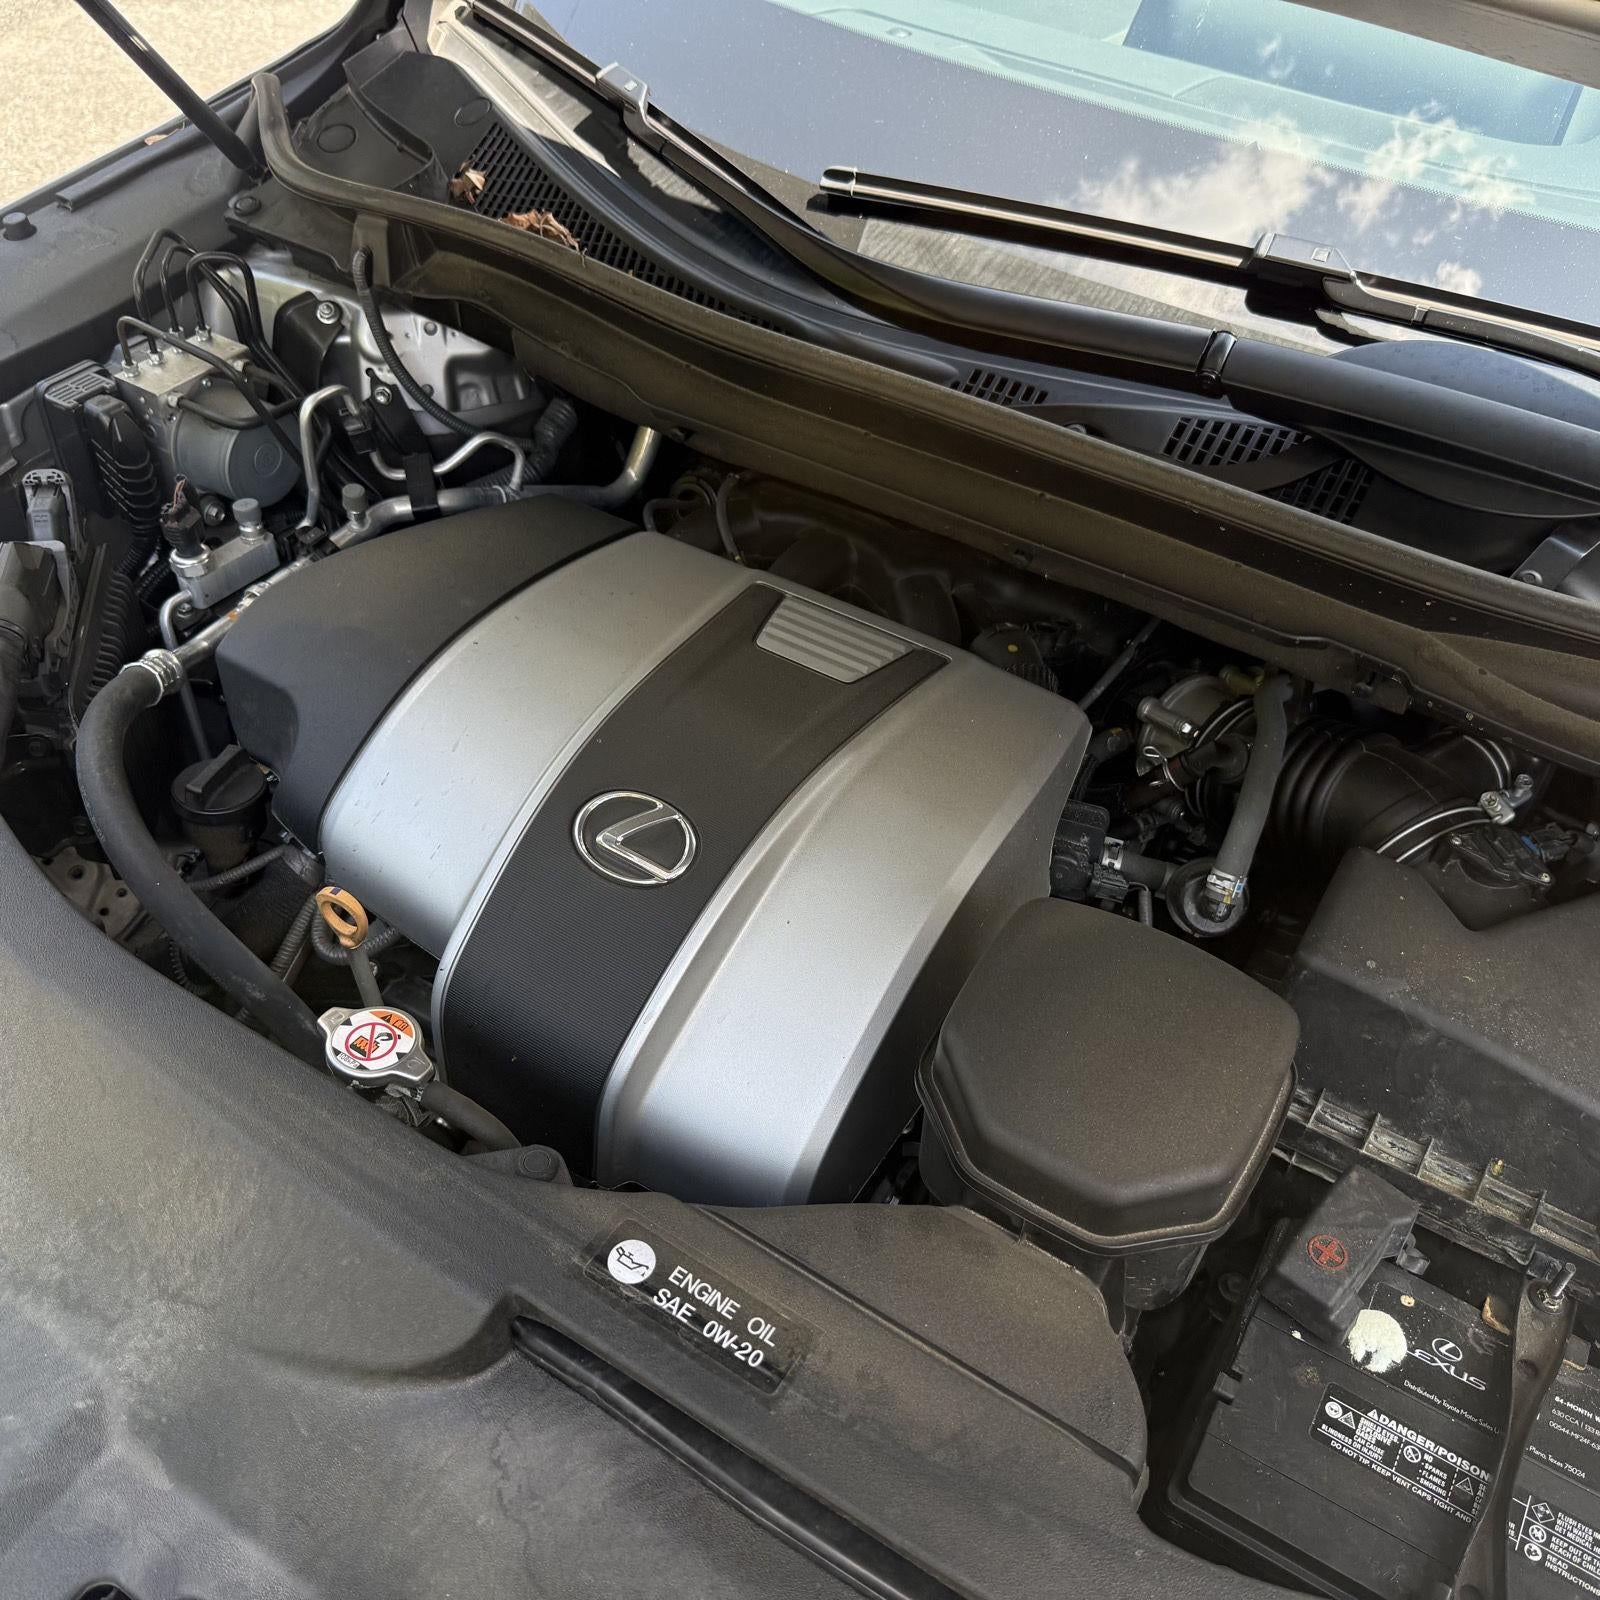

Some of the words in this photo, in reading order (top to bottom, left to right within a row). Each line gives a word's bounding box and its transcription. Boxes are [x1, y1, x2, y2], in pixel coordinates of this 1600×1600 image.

[668, 1265, 741, 1320] ENGINE
[747, 1317, 776, 1347] OIL
[653, 1288, 697, 1323] SAE
[702, 1320, 764, 1368] 0W-20
[1407, 1349, 1487, 1391] EXUS
[1403, 1379, 1435, 1400] Distributed
[1434, 1395, 1442, 1405] by
[1442, 1399, 1460, 1414] Toyota
[1460, 1408, 1478, 1423] Motor
[1478, 1418, 1493, 1432] Sales
[1552, 1408, 1565, 1419] 630
[1564, 1414, 1580, 1426] CCA
[1555, 1395, 1594, 1419] 84-MONTH
[1321, 1423, 1353, 1446] BLINDNESS
[1352, 1442, 1362, 1451] OR
[1355, 1428, 1376, 1444] GASES
[1358, 1422, 1392, 1446] EXPLOSIVE
[1360, 1417, 1382, 1433] SHIELD
[1353, 1434, 1366, 1447] CAN
[1365, 1442, 1385, 1457] CAUSE
[1379, 1414, 1490, 1482] DANGER/POISON
[1423, 1453, 1434, 1463] NO
[1548, 1454, 1563, 1468] Texas
[1563, 1462, 1586, 1479] 75024
[1330, 1440, 1342, 1450] DO
[1342, 1446, 1358, 1459] NOT
[1358, 1453, 1370, 1467] TIP.
[1371, 1462, 1392, 1477] KEEP
[1392, 1474, 1412, 1489] VENT
[1411, 1486, 1432, 1501] CAPS
[1432, 1497, 1455, 1514] TIGHT
[1455, 1511, 1472, 1523] AND
[1422, 1470, 1446, 1487] FLAMES
[1424, 1462, 1448, 1480] SPARKS
[1420, 1478, 1447, 1497] SMOKING
[1556, 1518, 1572, 1534] WITH
[1558, 1512, 1577, 1528] FLUSH
[1577, 1522, 1593, 1536] EYES
[1551, 1535, 1569, 1549] KEEP
[1568, 1545, 1583, 1556] OUT
[1583, 1553, 1592, 1562] OF
[1554, 1524, 1567, 1535] GET
[1566, 1530, 1593, 1550] MEDICAL
[1546, 1553, 1569, 1570] READ
[1549, 1542, 1572, 1560] REACH
[1572, 1555, 1582, 1564] OF
[1545, 1560, 1600, 1597] INSTRUCTIONS
